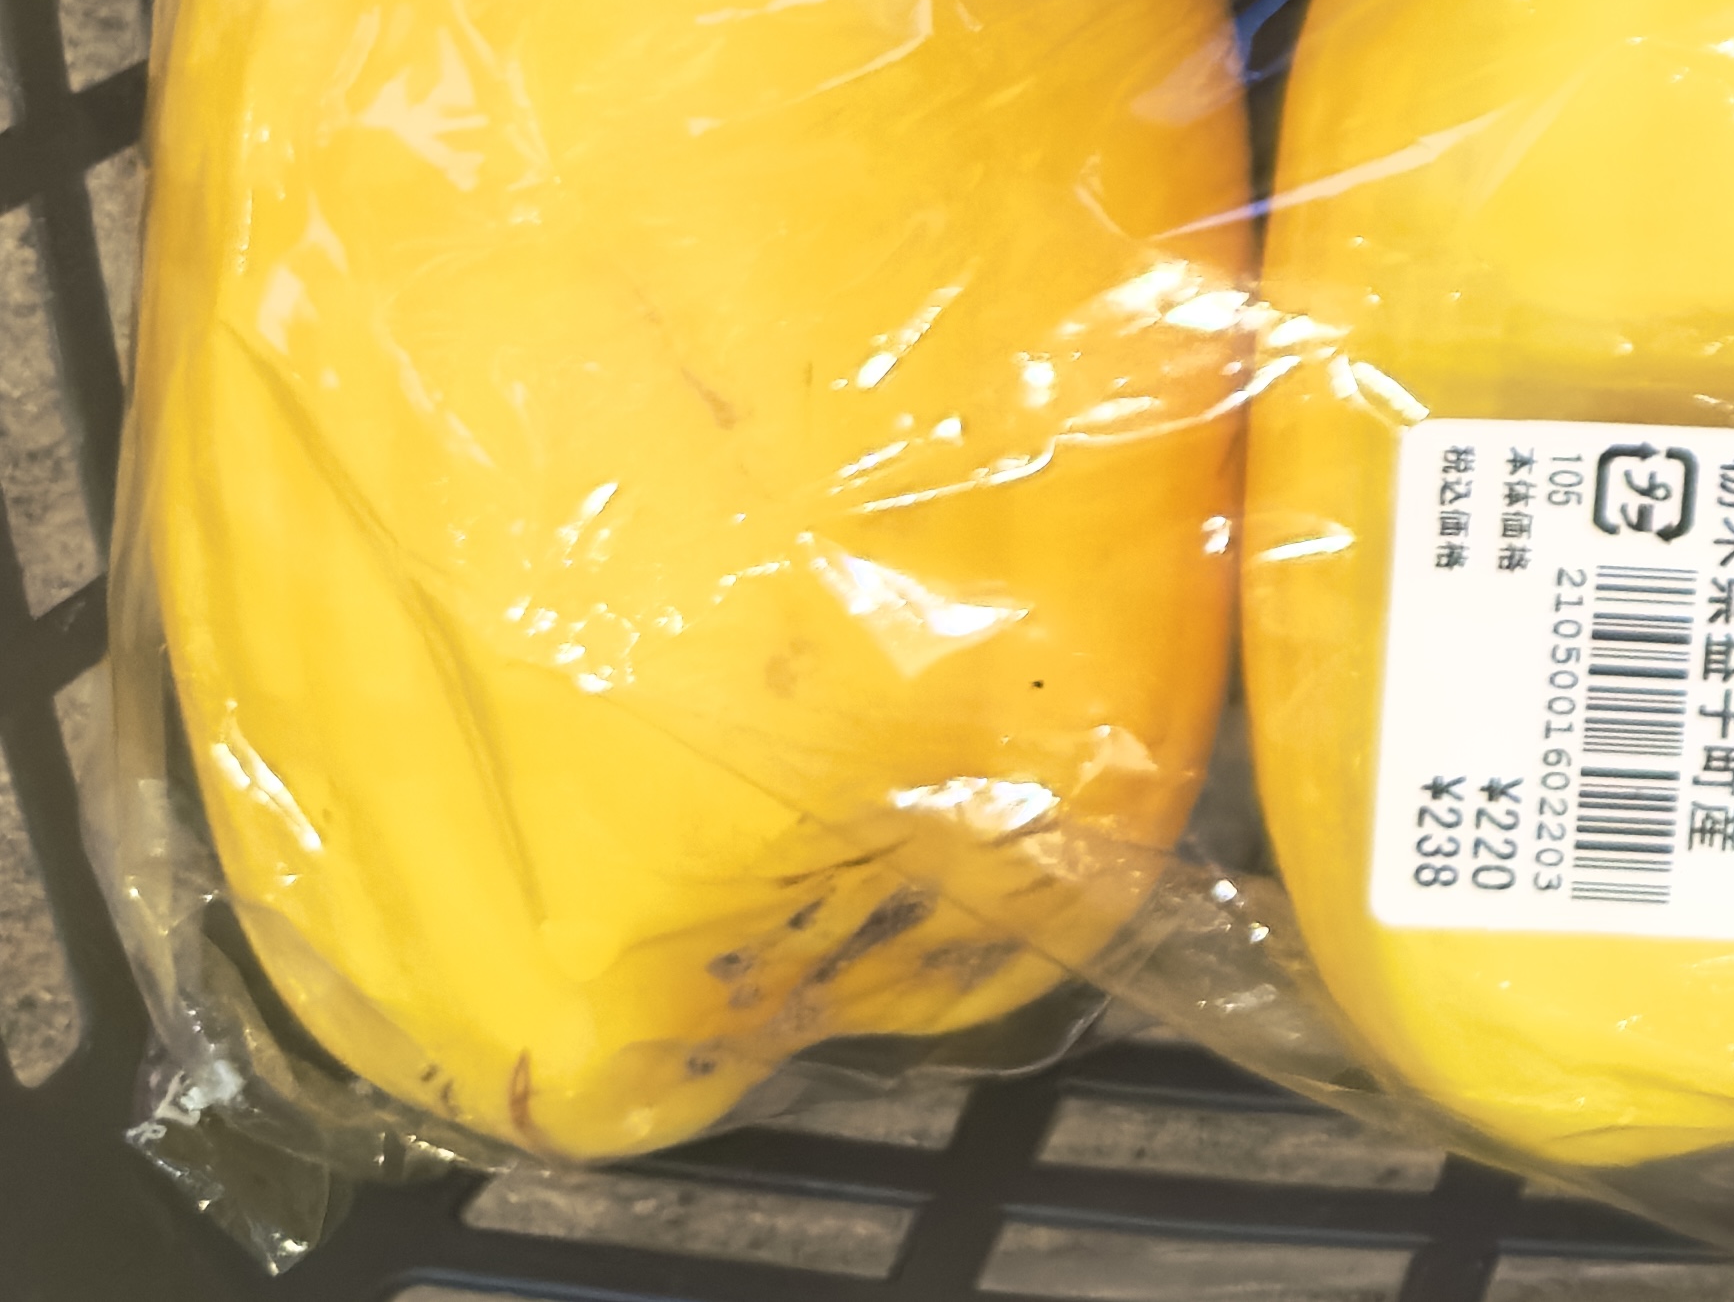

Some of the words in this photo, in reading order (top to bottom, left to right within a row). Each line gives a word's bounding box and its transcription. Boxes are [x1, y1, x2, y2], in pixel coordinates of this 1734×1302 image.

[1433, 446, 1475, 571] 税込価格
[1496, 449, 1536, 573] 本体価格
[1545, 453, 1585, 508] 105
[1531, 566, 1589, 893] 2105001602203
[1412, 775, 1467, 889] ¥238
[1470, 777, 1524, 892] ¥220
